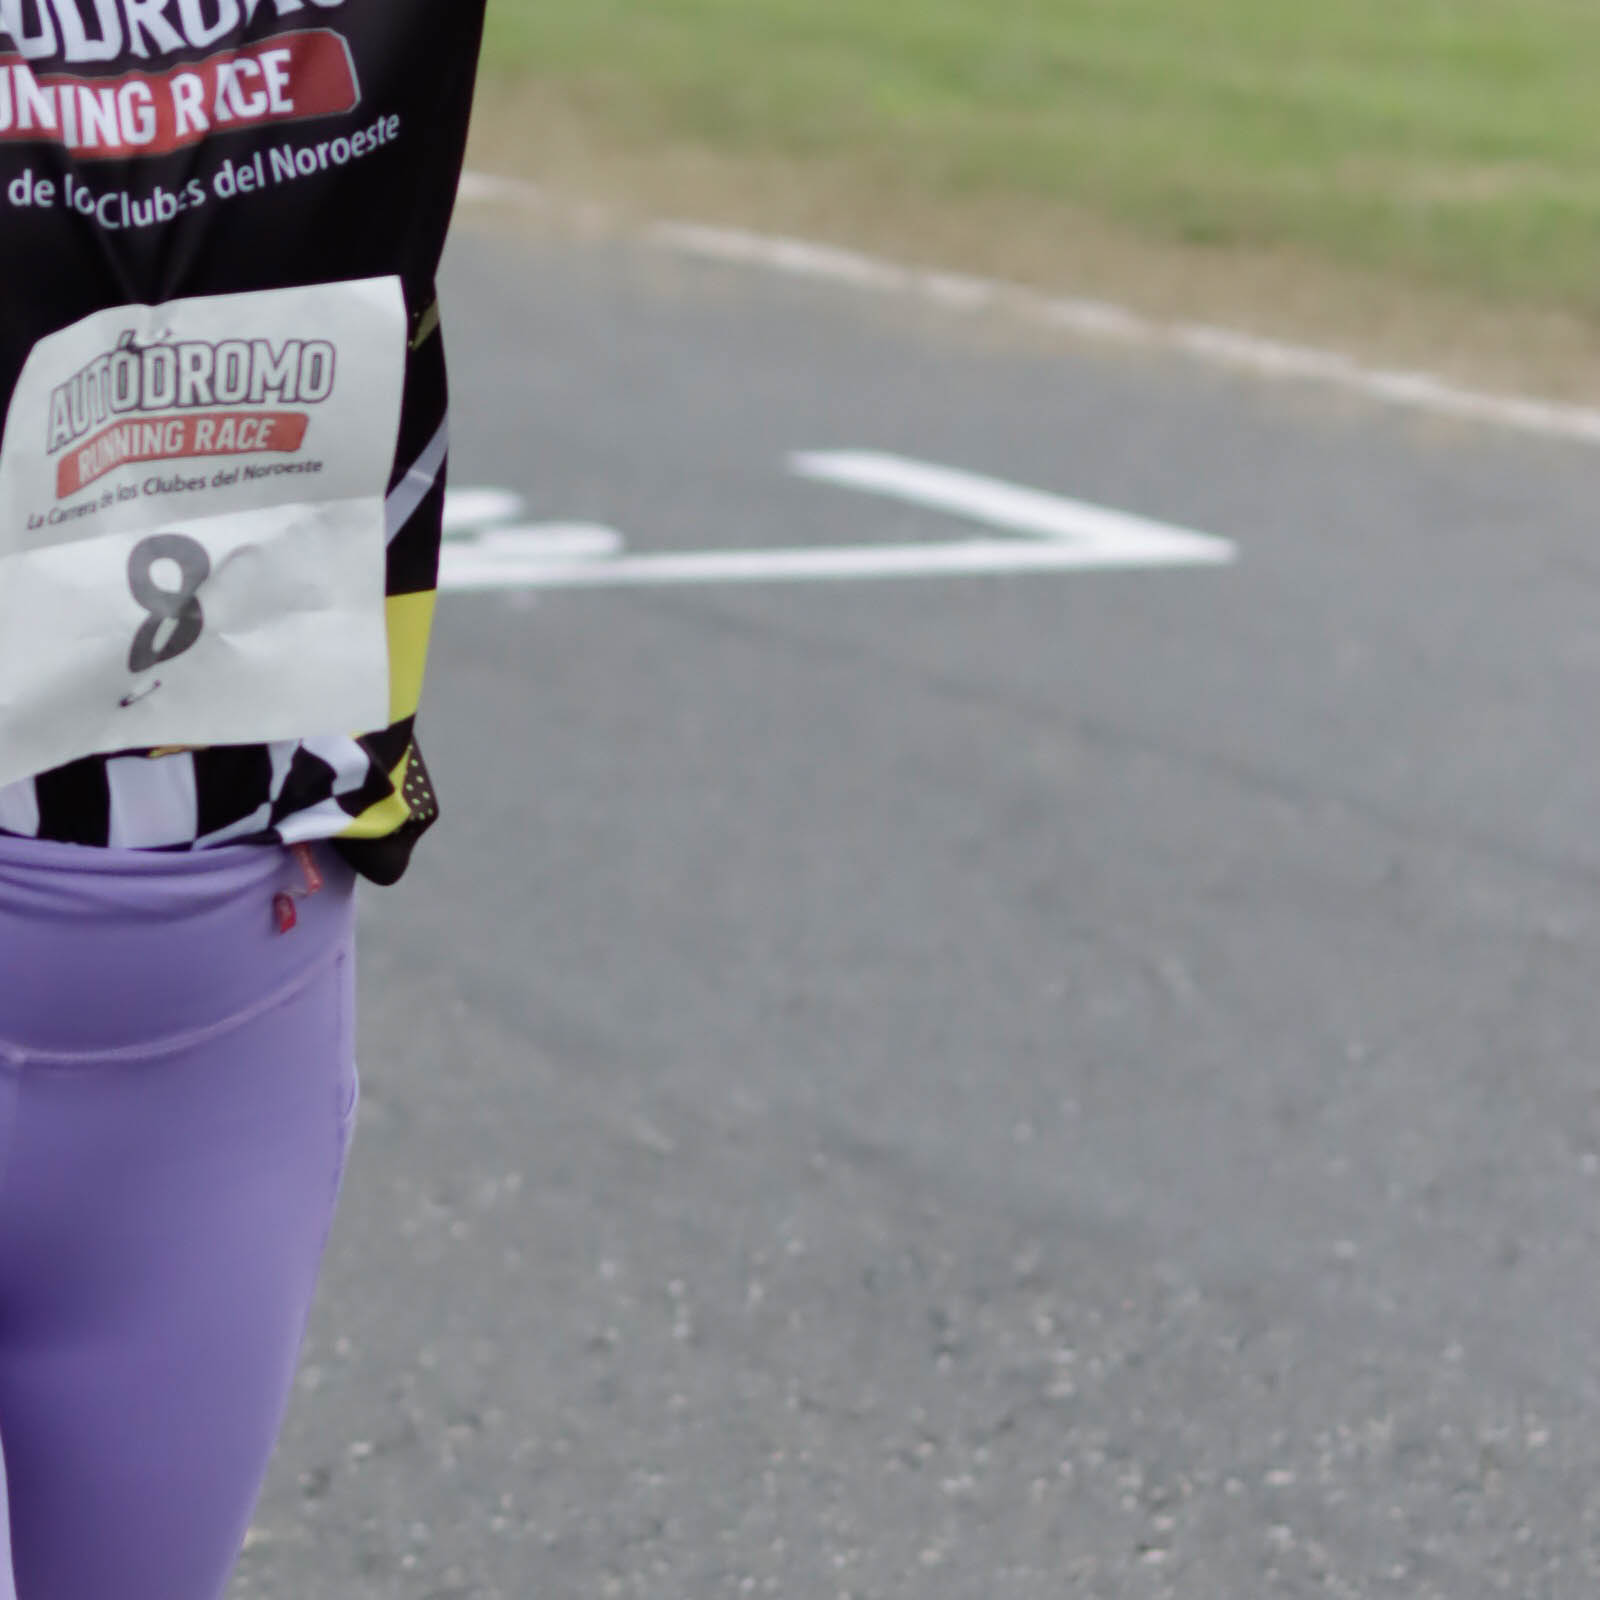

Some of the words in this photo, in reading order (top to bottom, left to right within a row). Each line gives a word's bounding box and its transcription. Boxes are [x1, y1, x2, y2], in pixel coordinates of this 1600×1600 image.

[8, 167, 55, 207] de
[64, 172, 96, 215] lo
[213, 159, 266, 200] del
[270, 114, 401, 183] Noroeste
[194, 417, 275, 453] RACE
[26, 512, 44, 530] La
[48, 501, 97, 526] Carrera
[117, 483, 138, 501] los
[143, 472, 206, 496] Clubes
[211, 467, 239, 488] del
[243, 459, 322, 481] Noroeste
[127, 533, 211, 674] 8
